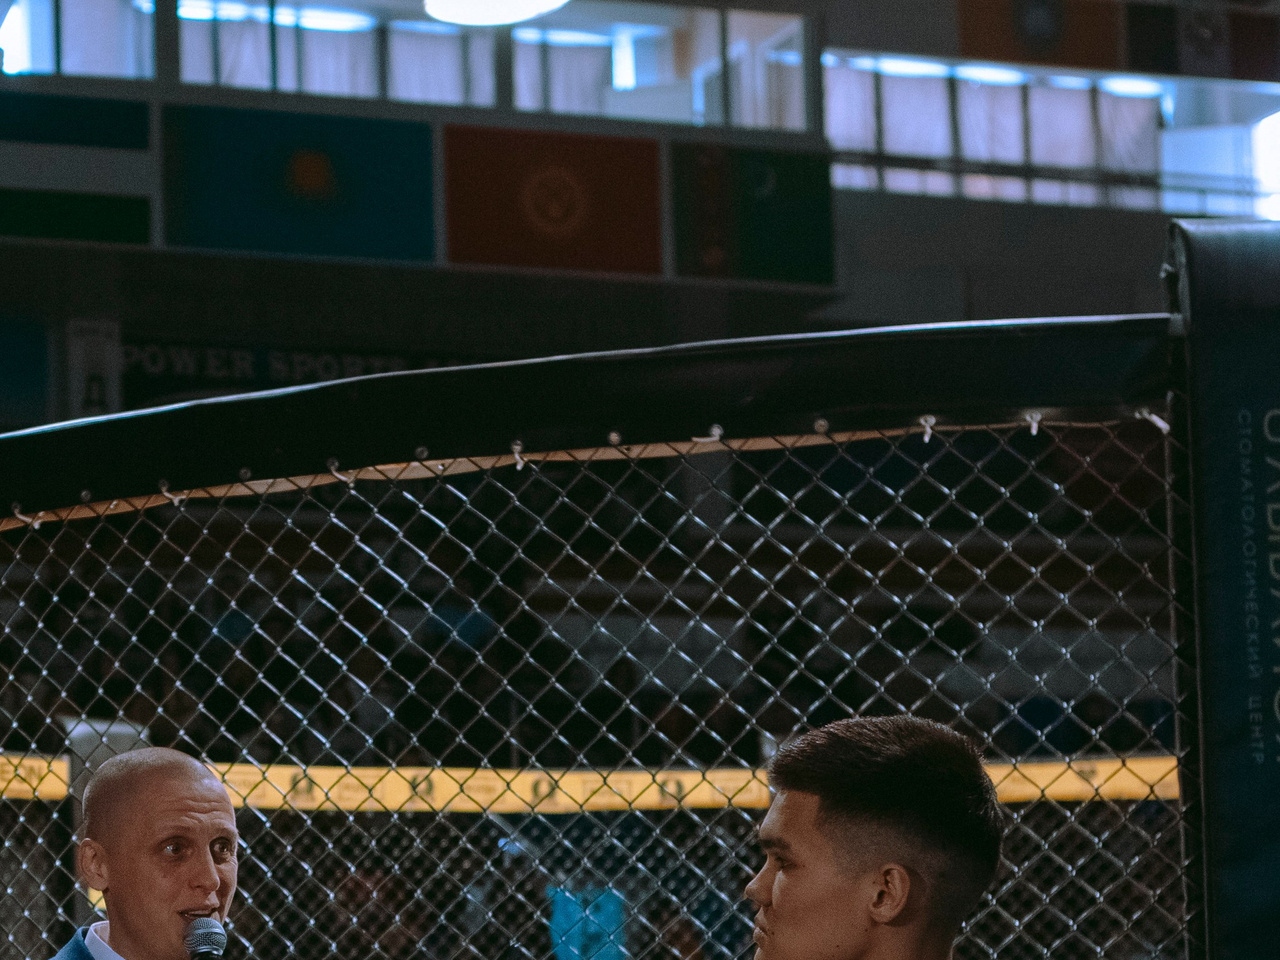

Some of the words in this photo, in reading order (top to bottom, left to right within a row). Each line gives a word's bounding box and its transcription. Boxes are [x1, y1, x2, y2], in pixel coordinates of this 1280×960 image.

[122, 344, 255, 378] POWER
[1237, 408, 1264, 679] СТОМАТОЛОГИЧЕСКИЙ
[1247, 693, 1266, 765] ЦЕНТР
